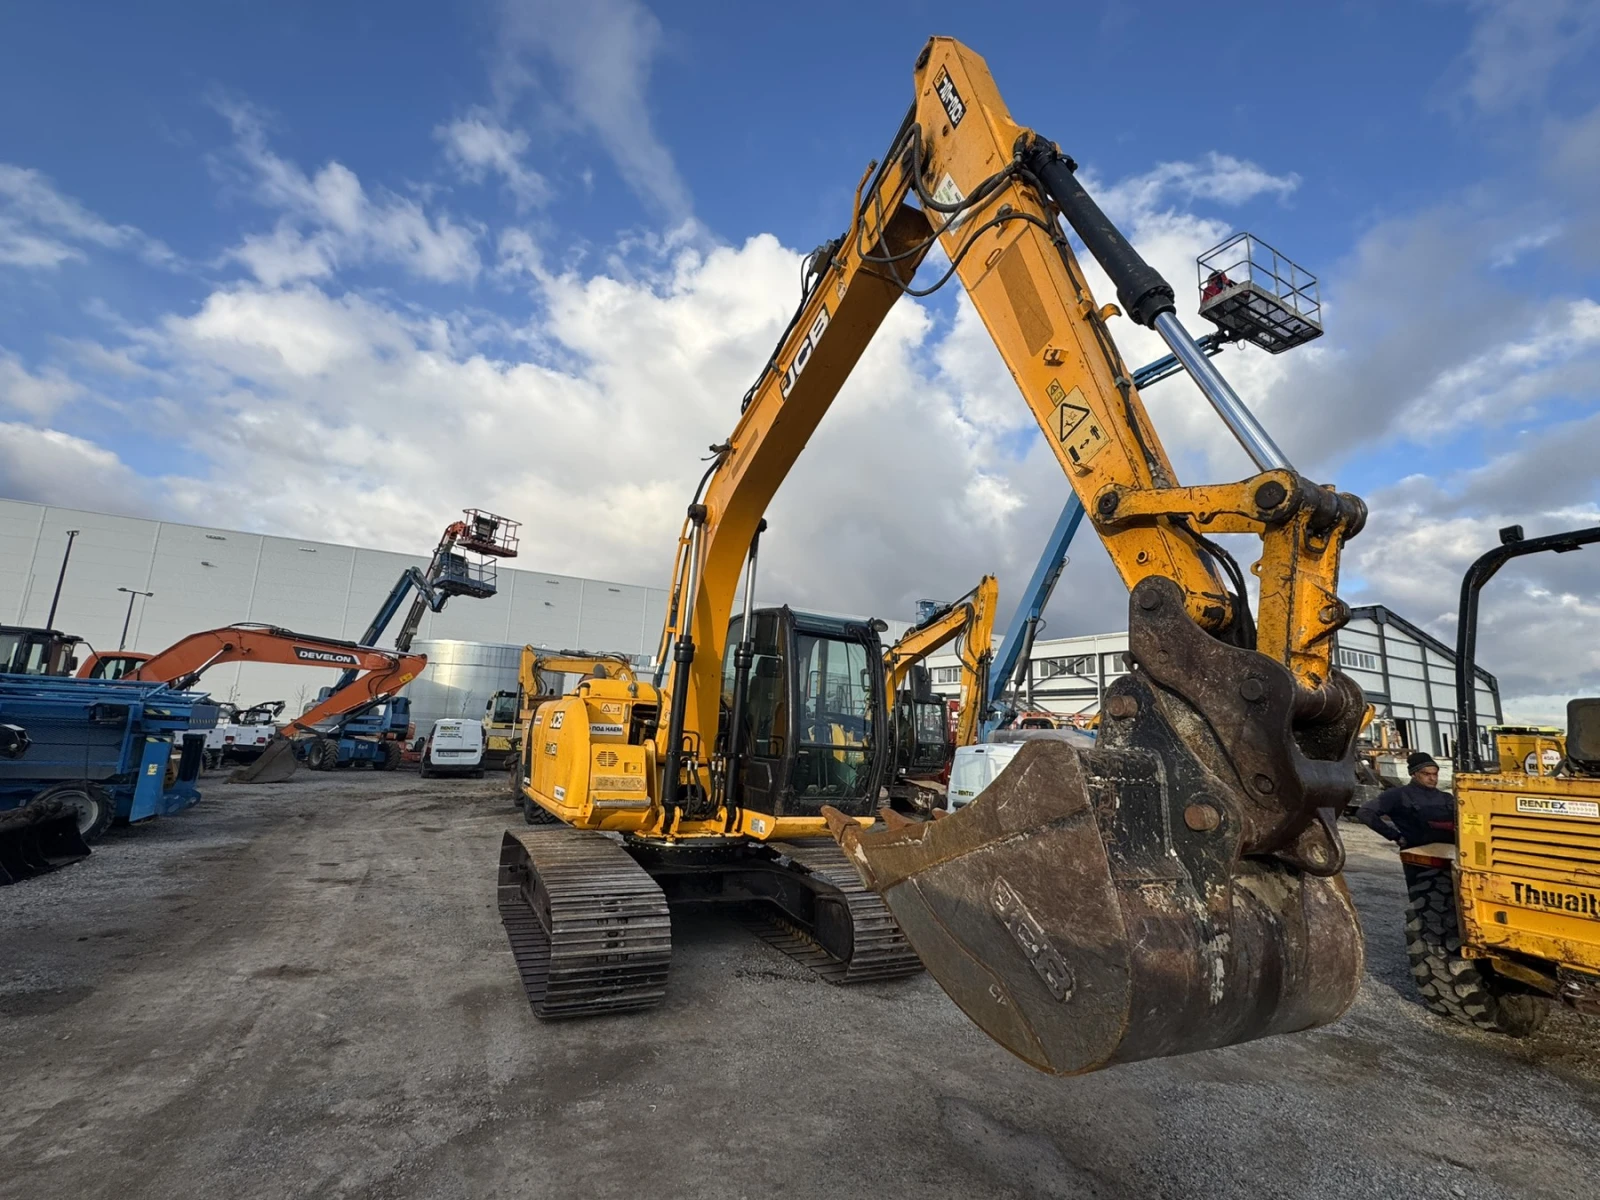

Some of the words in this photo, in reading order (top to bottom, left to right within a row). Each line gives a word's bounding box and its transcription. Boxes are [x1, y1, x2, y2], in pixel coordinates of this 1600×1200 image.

[783, 308, 830, 398] JCB
[299, 650, 351, 663] DEVELON
[1519, 799, 1566, 809] RENTEX
[1511, 882, 1600, 917] Thwait
